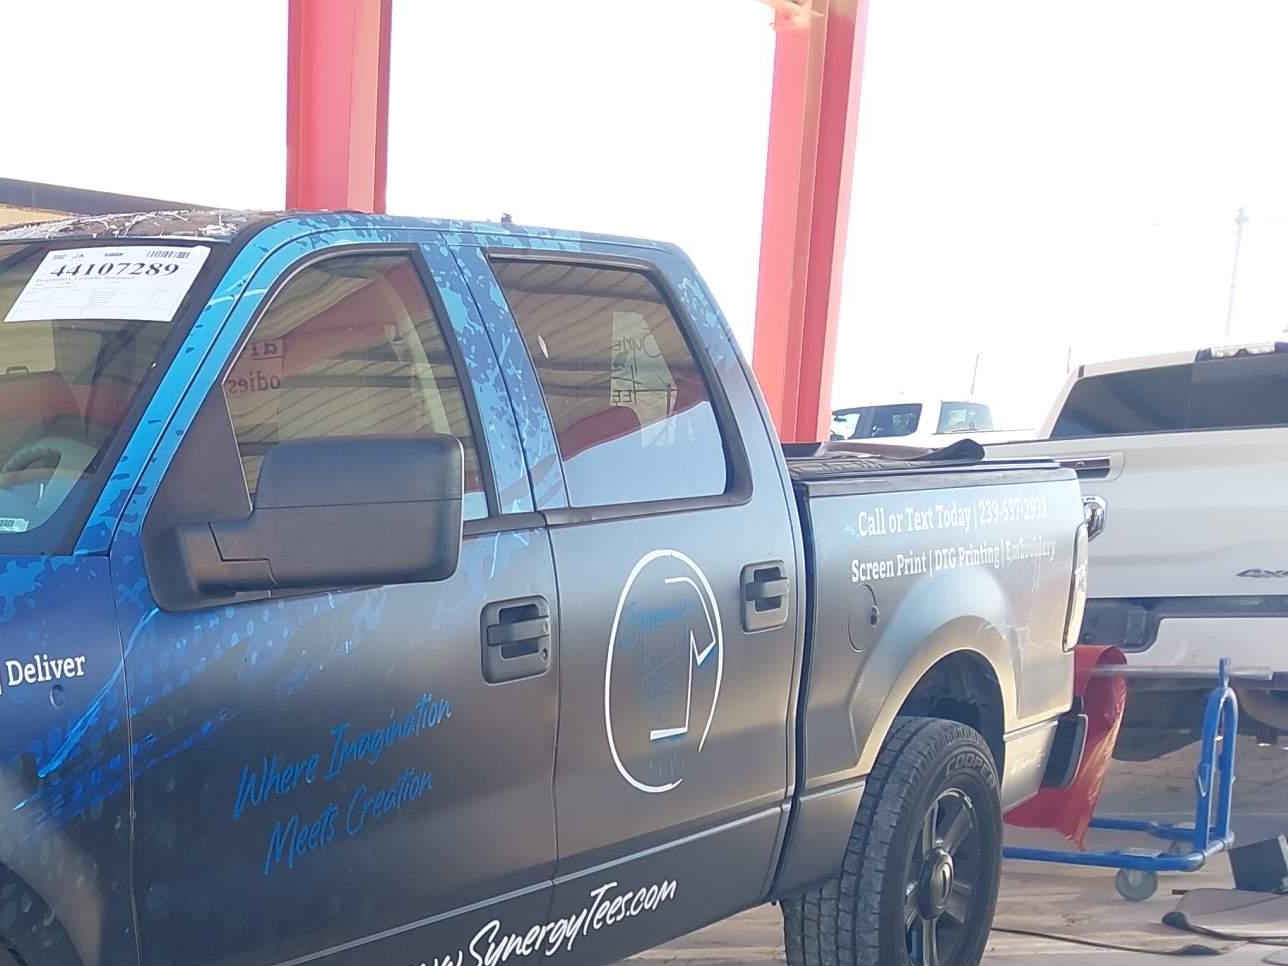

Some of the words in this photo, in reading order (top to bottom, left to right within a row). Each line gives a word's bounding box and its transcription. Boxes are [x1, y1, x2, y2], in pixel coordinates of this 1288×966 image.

[50, 262, 180, 277] 44107289
[858, 507, 887, 537] Call
[888, 513, 904, 534] or
[905, 505, 934, 531] Text
[935, 500, 972, 533] Today
[852, 559, 895, 583] Screen
[896, 550, 928, 577] Print
[934, 547, 957, 571] DTG
[958, 540, 1000, 569] Printing
[5, 654, 86, 686] Deliver
[232, 751, 320, 821] Where
[324, 692, 452, 781] Imagination
[264, 802, 340, 876] Meets
[346, 767, 433, 836] Creation
